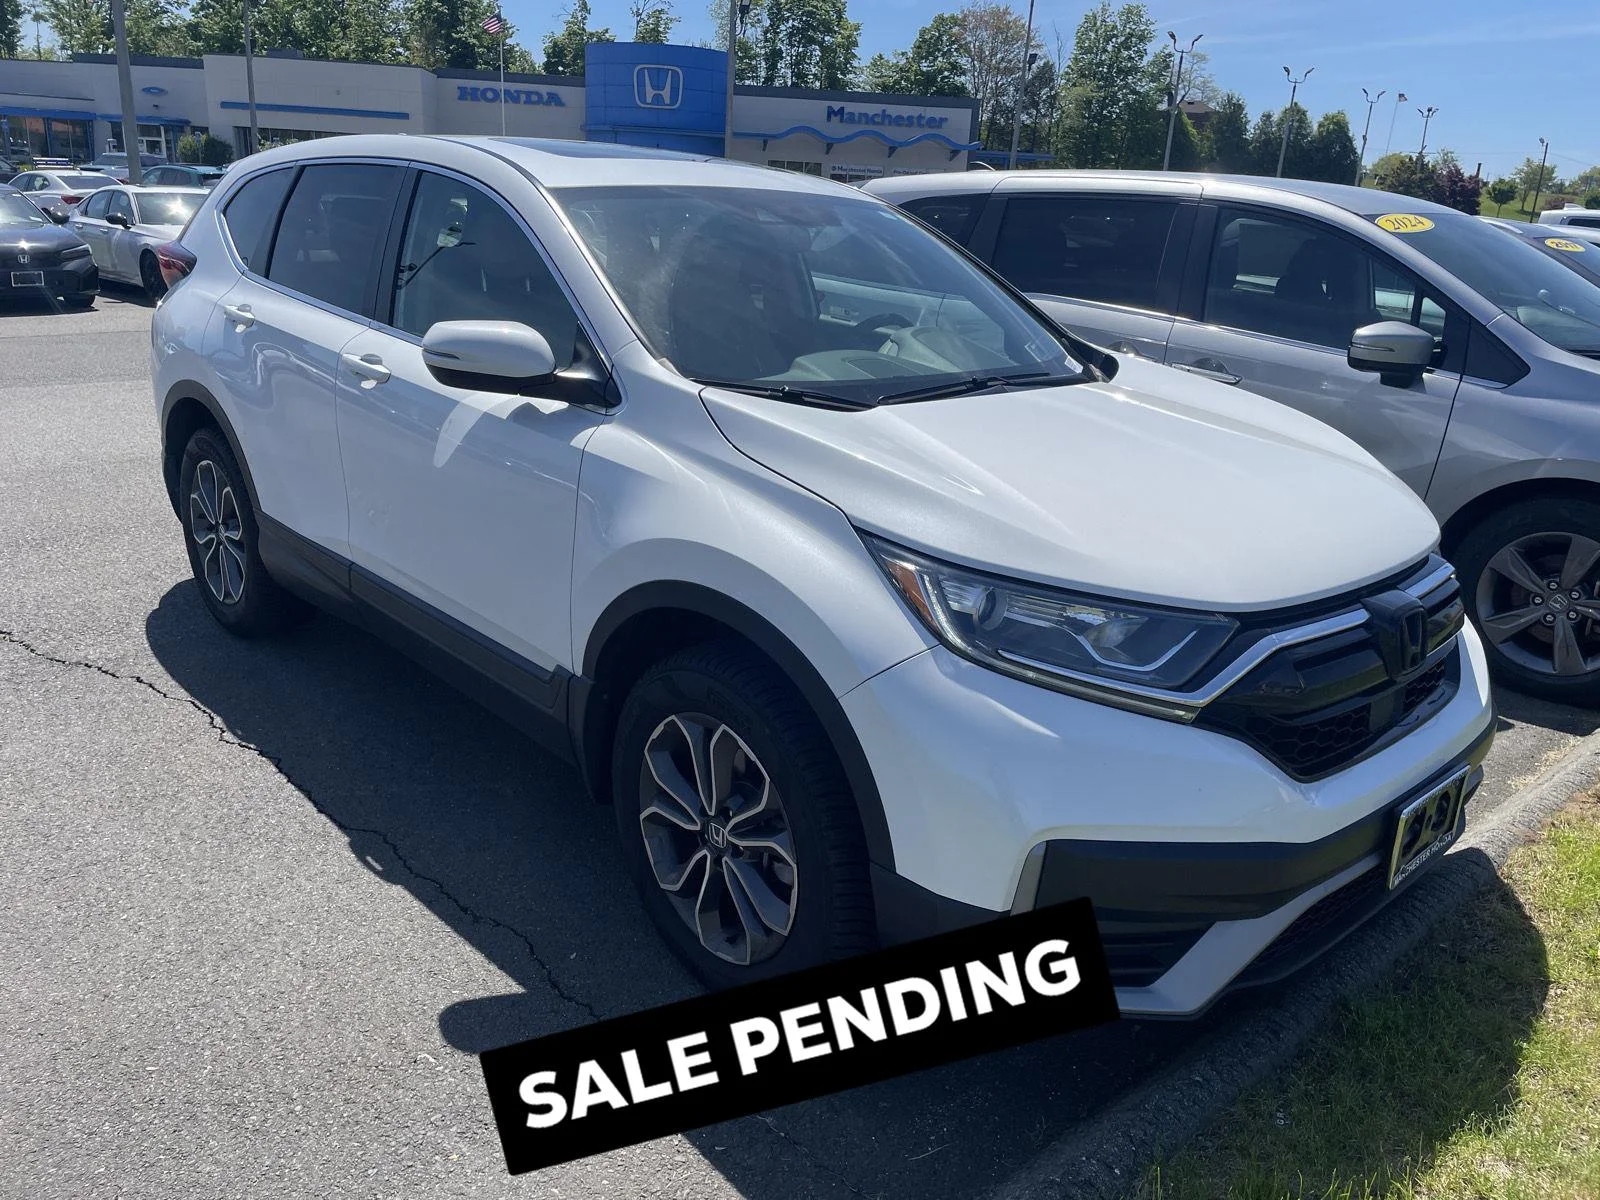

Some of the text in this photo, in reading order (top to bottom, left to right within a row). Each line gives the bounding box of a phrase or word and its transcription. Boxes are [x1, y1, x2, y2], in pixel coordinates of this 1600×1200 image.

[457, 85, 567, 107] HONDA
[826, 105, 949, 129] Manchester
[1385, 215, 1426, 231] 2024
